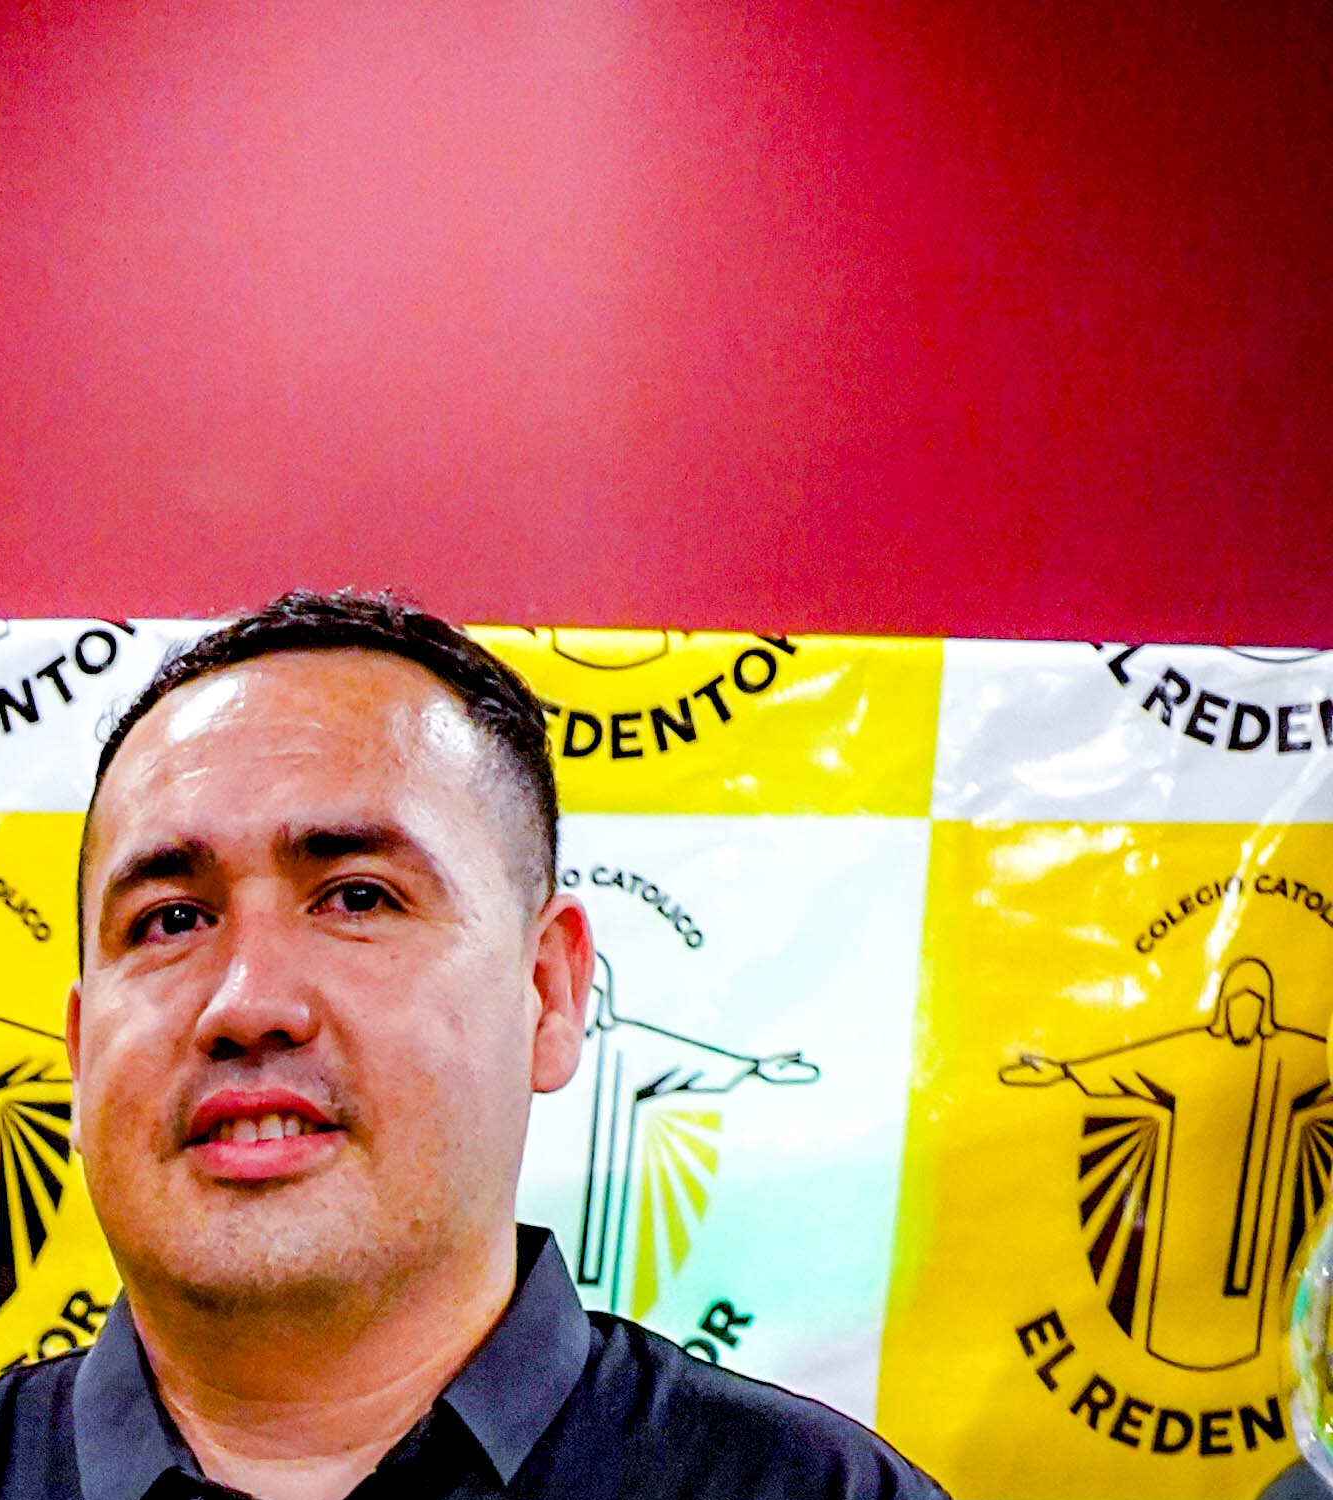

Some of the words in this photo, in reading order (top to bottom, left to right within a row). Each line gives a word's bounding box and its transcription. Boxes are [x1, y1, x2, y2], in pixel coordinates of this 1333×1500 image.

[541, 633, 798, 759] DENTO
[1090, 641, 1144, 688] L
[1141, 665, 1333, 754] REDE
[591, 867, 704, 950] CATOLICO
[1255, 874, 1333, 928] CATOL
[1015, 1308, 1076, 1393] EL
[1069, 1372, 1288, 1458] REDEN
